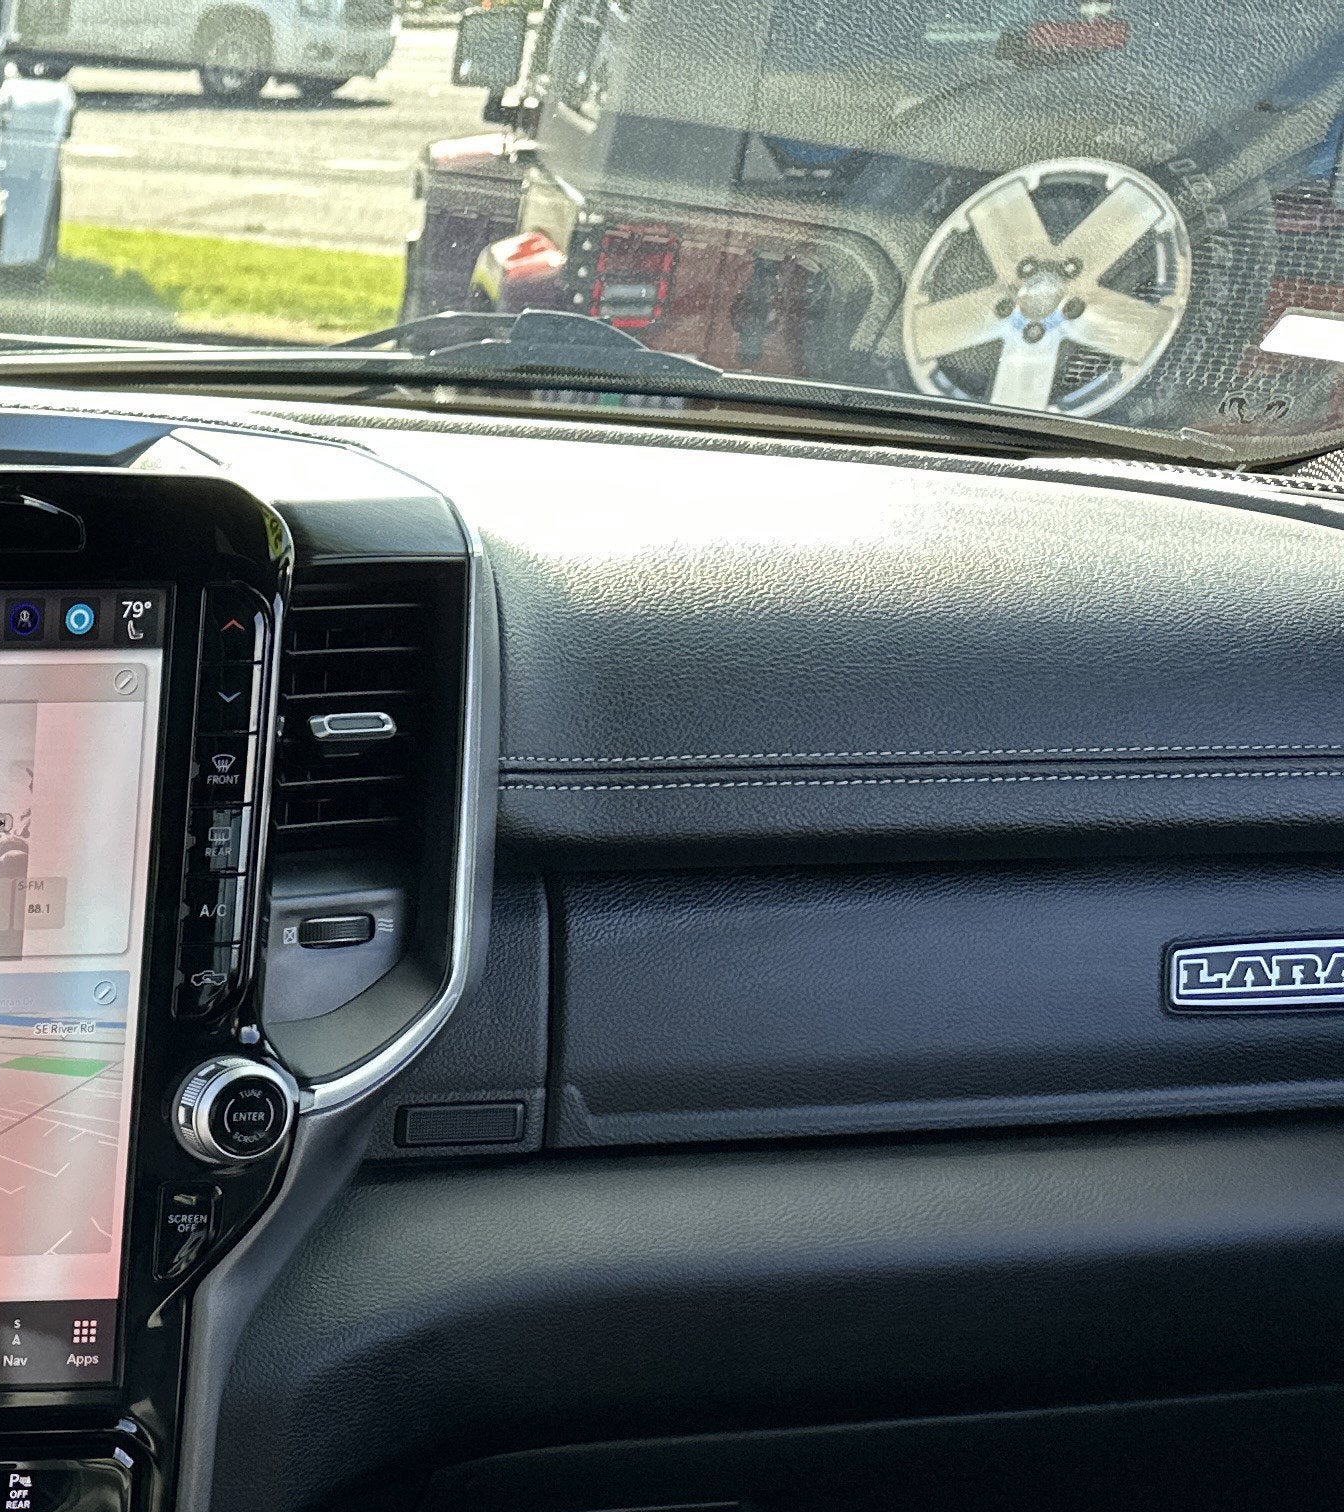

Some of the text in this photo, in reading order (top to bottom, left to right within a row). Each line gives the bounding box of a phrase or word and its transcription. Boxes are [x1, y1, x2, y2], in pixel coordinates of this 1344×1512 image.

[206, 774, 240, 785] FRONT
[204, 847, 232, 858] REAR
[199, 903, 228, 918] A/C
[34, 1022, 95, 1035] SE River Rd
[238, 1088, 263, 1100] TUNE
[232, 1111, 266, 1123] ENTER
[167, 1213, 208, 1225] SCREEN
[177, 1224, 198, 1234] OFF
[2, 1354, 28, 1368] Nav
[66, 1353, 100, 1368] Apps
[9, 1489, 29, 1499] OFF
[5, 1500, 31, 1510] REAR
